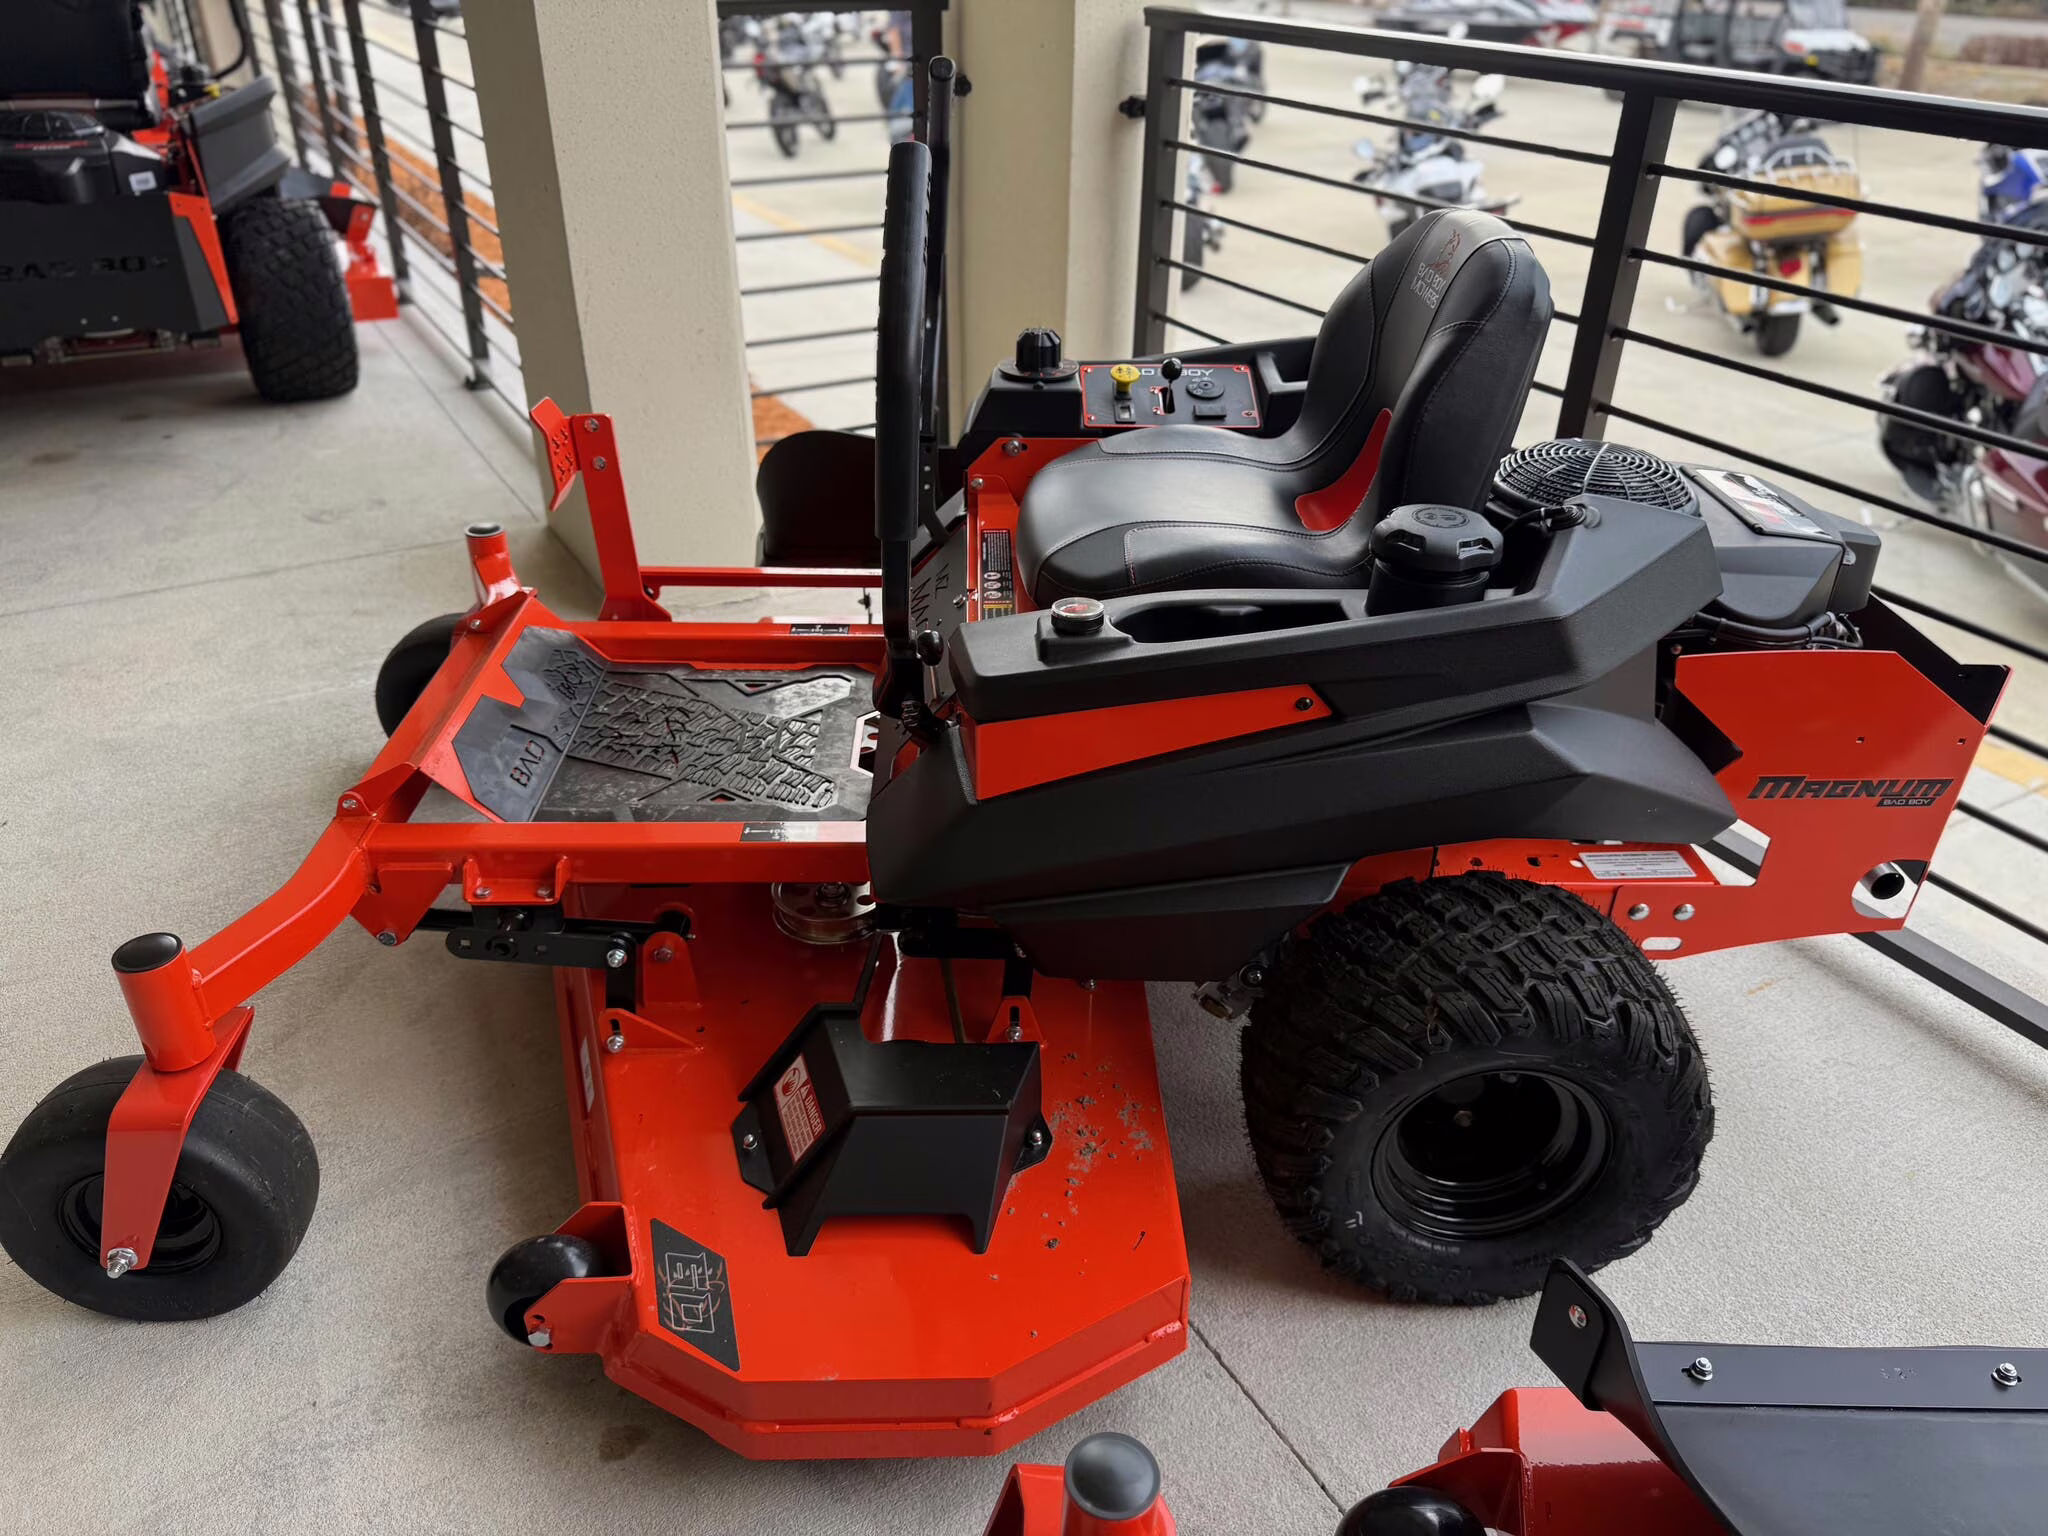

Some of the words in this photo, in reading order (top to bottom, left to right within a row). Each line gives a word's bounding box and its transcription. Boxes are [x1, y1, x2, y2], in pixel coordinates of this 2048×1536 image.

[1747, 775, 1954, 799] MAGNUM
[1883, 798, 1906, 806] BAD
[1908, 798, 1931, 806] BOY
[805, 1095, 823, 1136] DANGER
